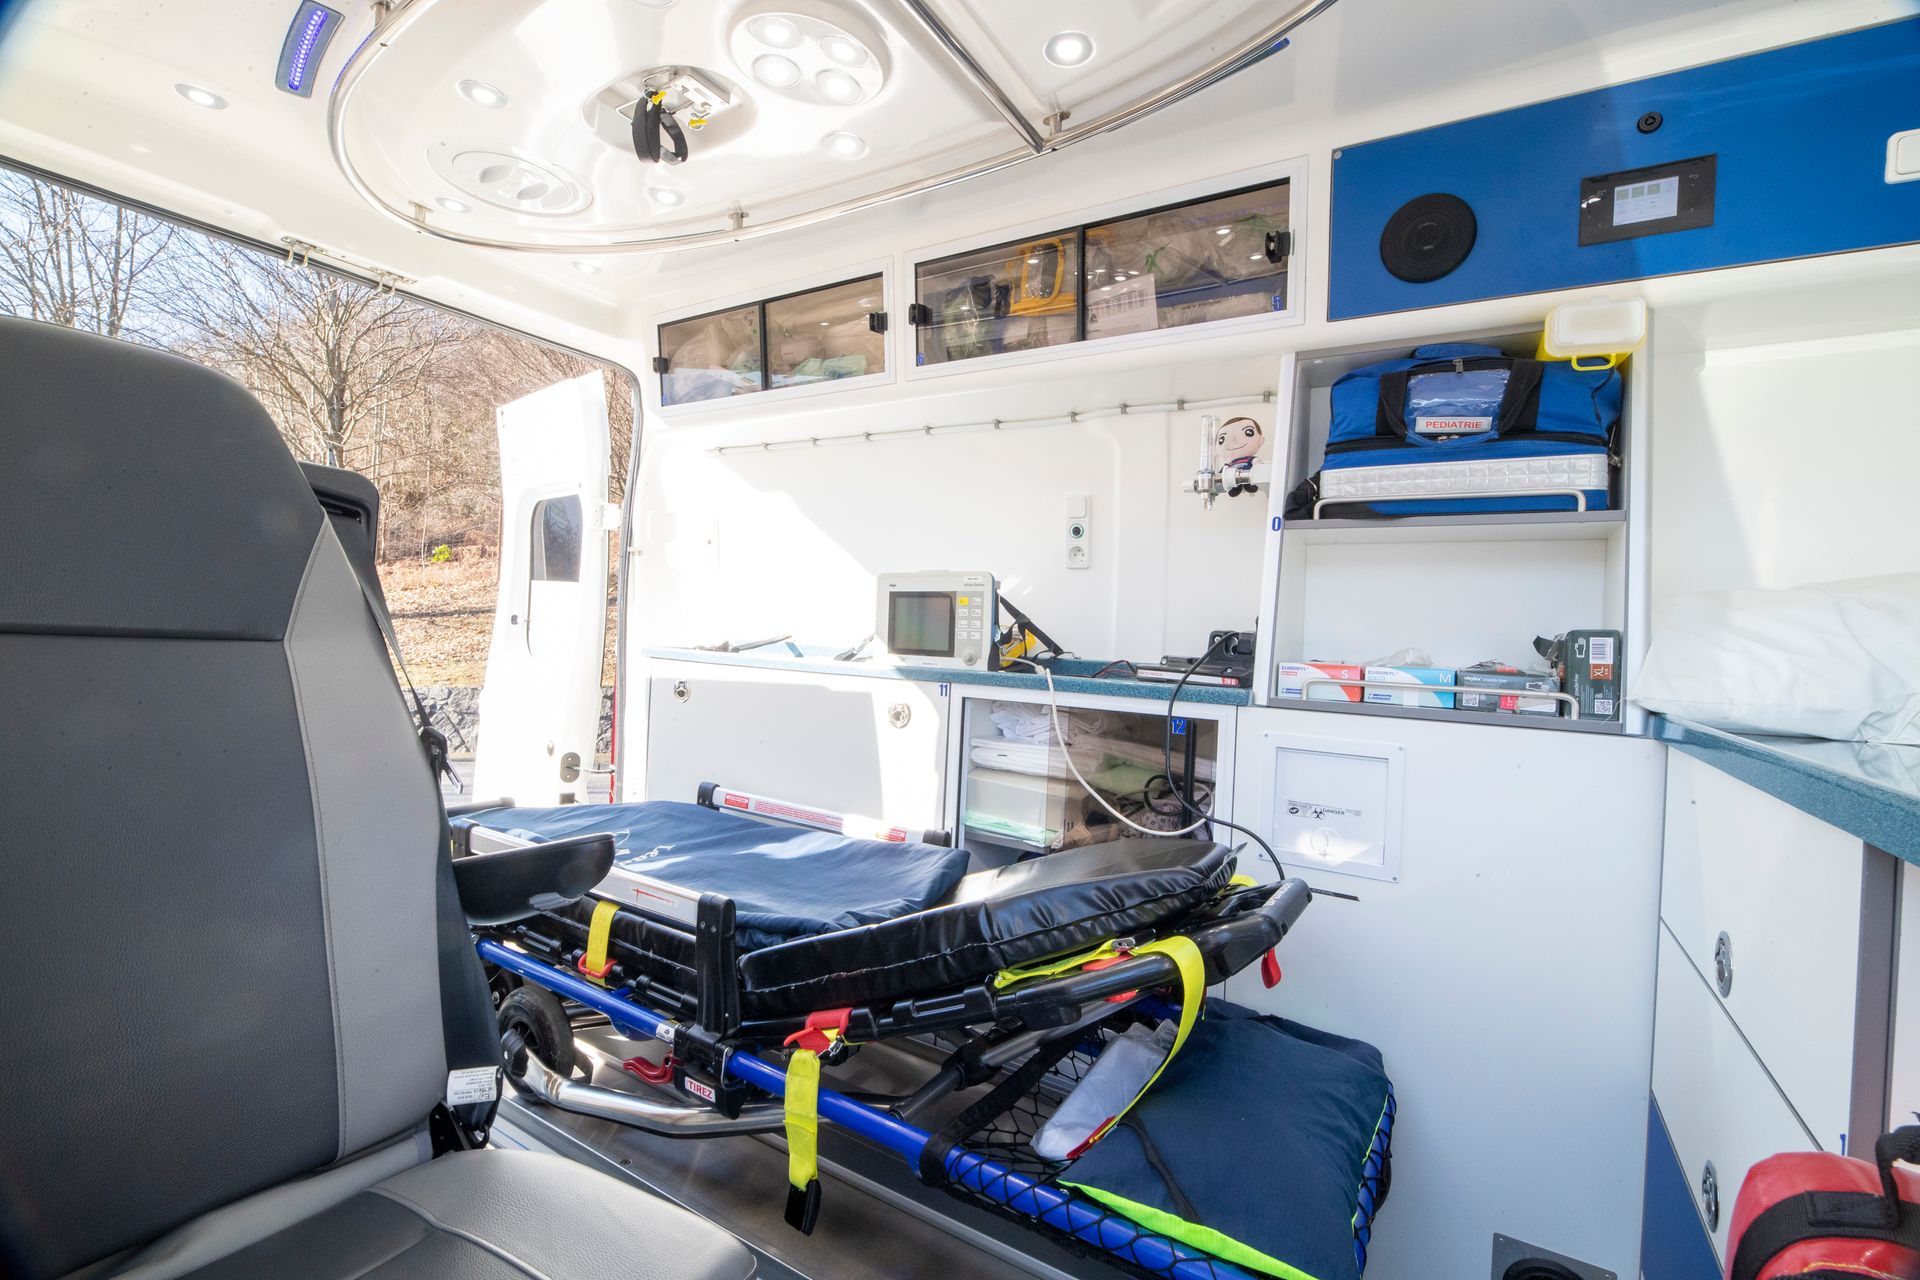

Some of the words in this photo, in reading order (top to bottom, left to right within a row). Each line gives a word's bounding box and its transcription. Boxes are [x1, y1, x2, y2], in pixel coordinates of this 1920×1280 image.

[1425, 421, 1482, 429] PEDIATRIE
[1271, 516, 1282, 532] 0
[1341, 669, 1349, 678] S
[1593, 666, 1604, 677] XL
[1439, 673, 1452, 683] M
[938, 683, 948, 697] 11
[1171, 719, 1187, 736] 12
[1322, 808, 1346, 816] DANGER
[688, 1080, 713, 1100] TIREZ
